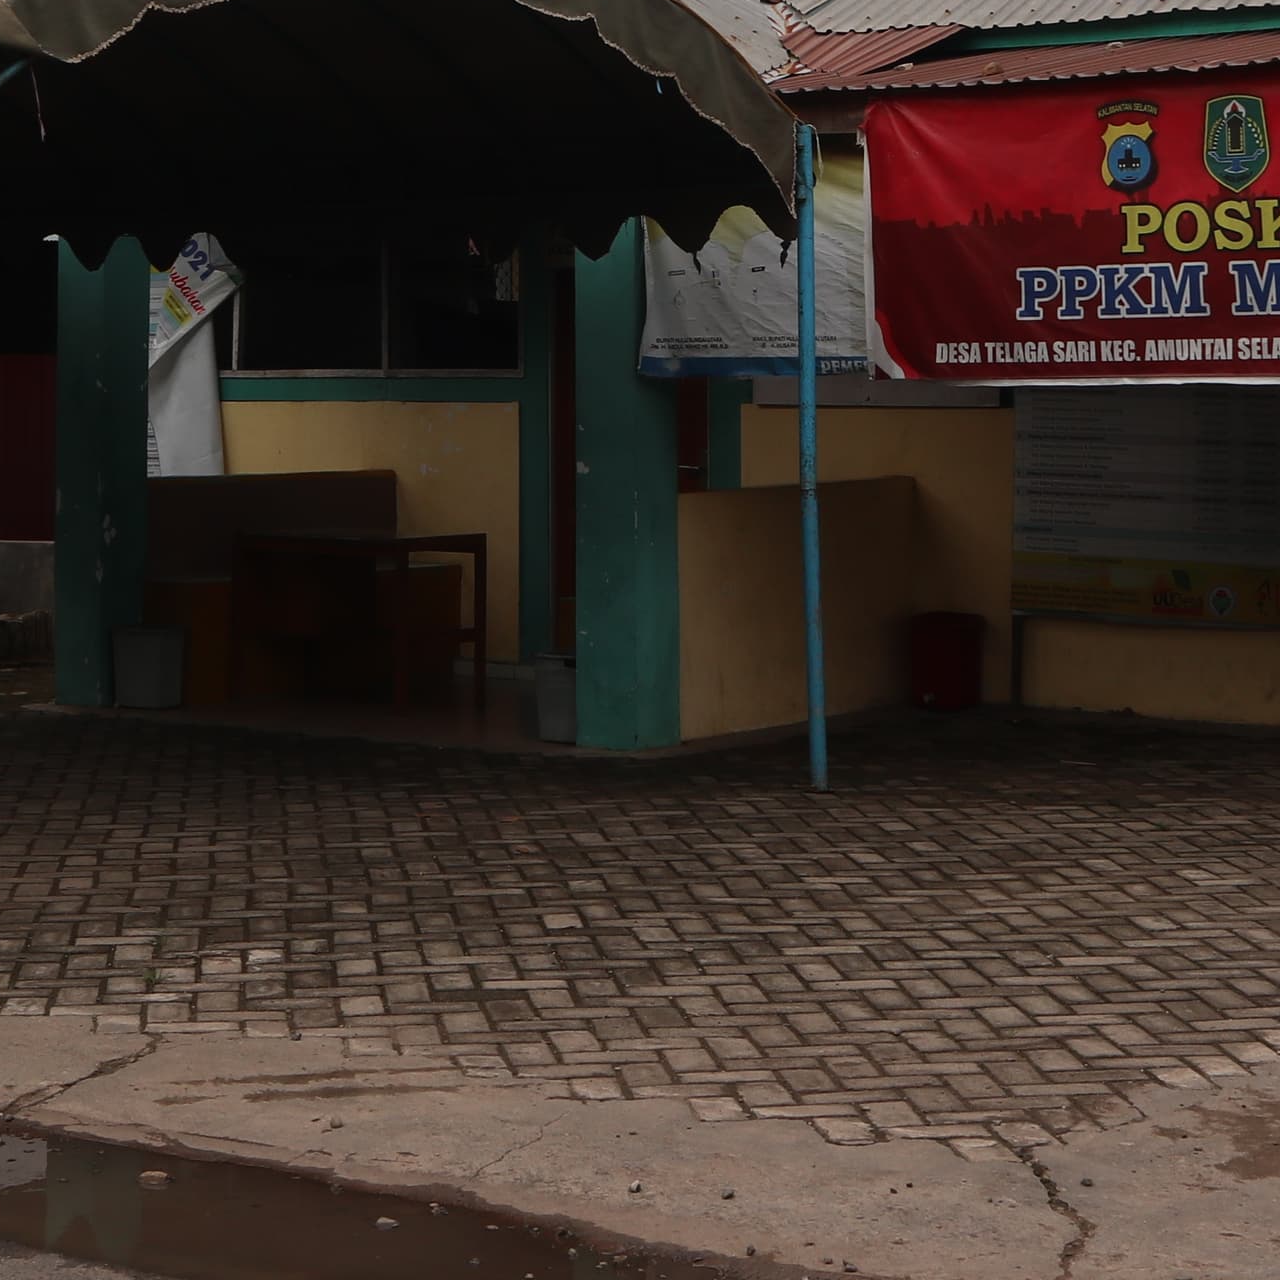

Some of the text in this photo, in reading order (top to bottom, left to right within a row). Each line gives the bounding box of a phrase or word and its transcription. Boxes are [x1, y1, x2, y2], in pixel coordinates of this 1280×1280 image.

[1017, 262, 1210, 320] PPKM
[935, 342, 981, 363] DESA
[985, 341, 1049, 363] TELAGA
[1052, 341, 1096, 362] SARI
[1100, 339, 1141, 362] KEC.
[1145, 338, 1233, 361] AMUNTAI
